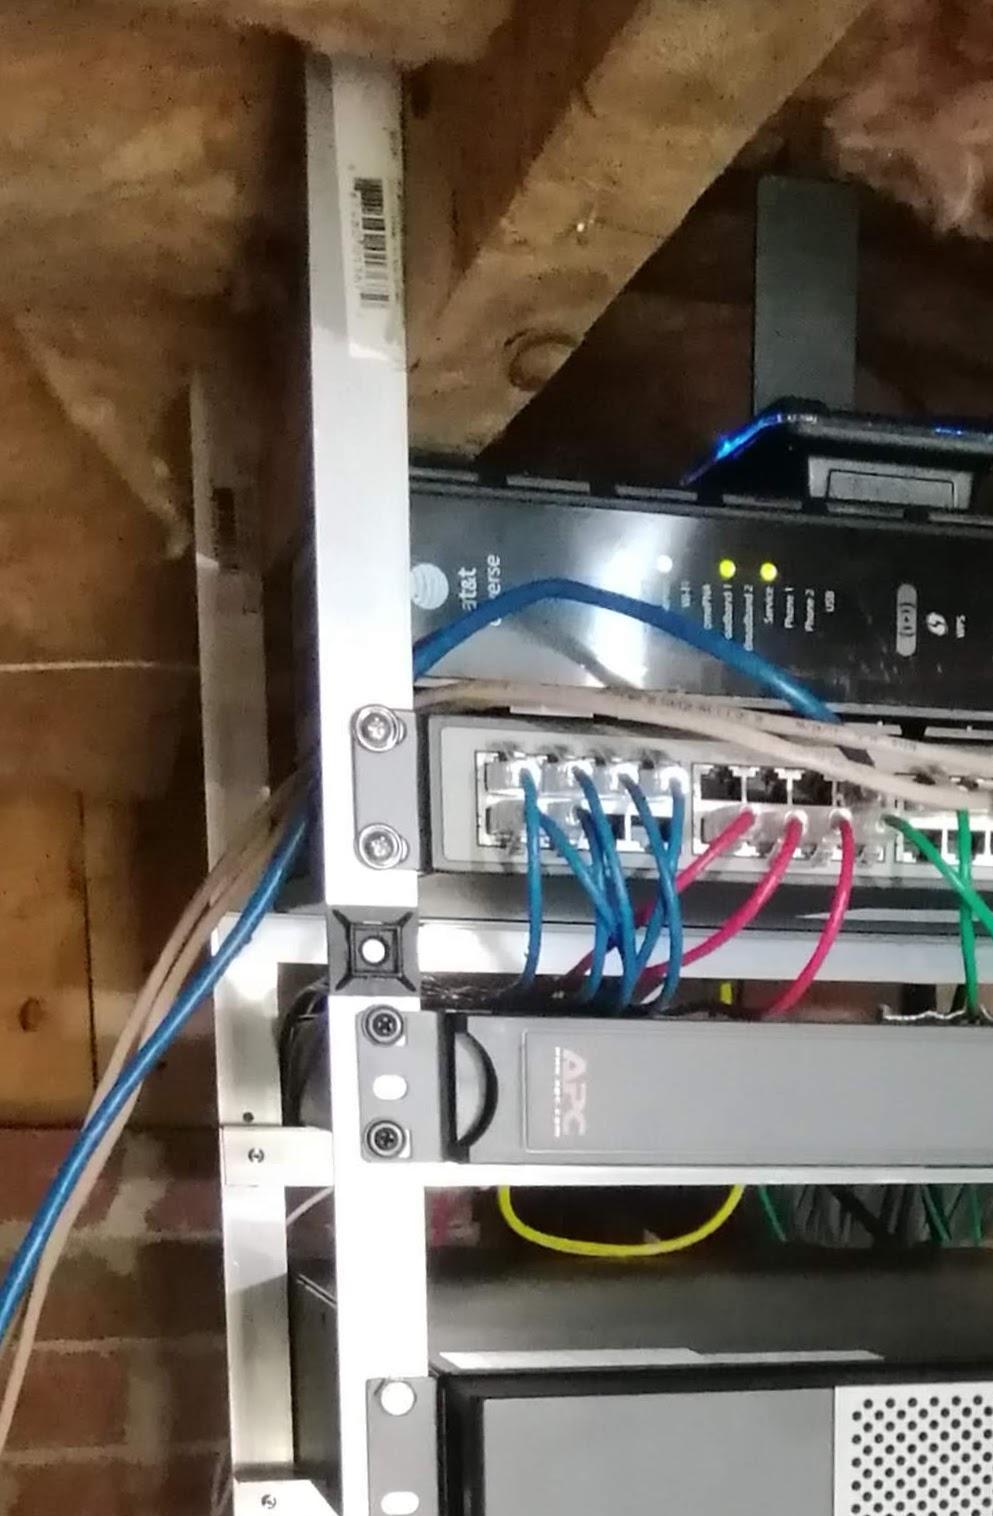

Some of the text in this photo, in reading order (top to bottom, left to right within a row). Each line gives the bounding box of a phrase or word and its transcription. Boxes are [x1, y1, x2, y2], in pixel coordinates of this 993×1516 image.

[763, 586, 774, 625] Service
[784, 594, 794, 629] Phone
[804, 597, 815, 632] Phone
